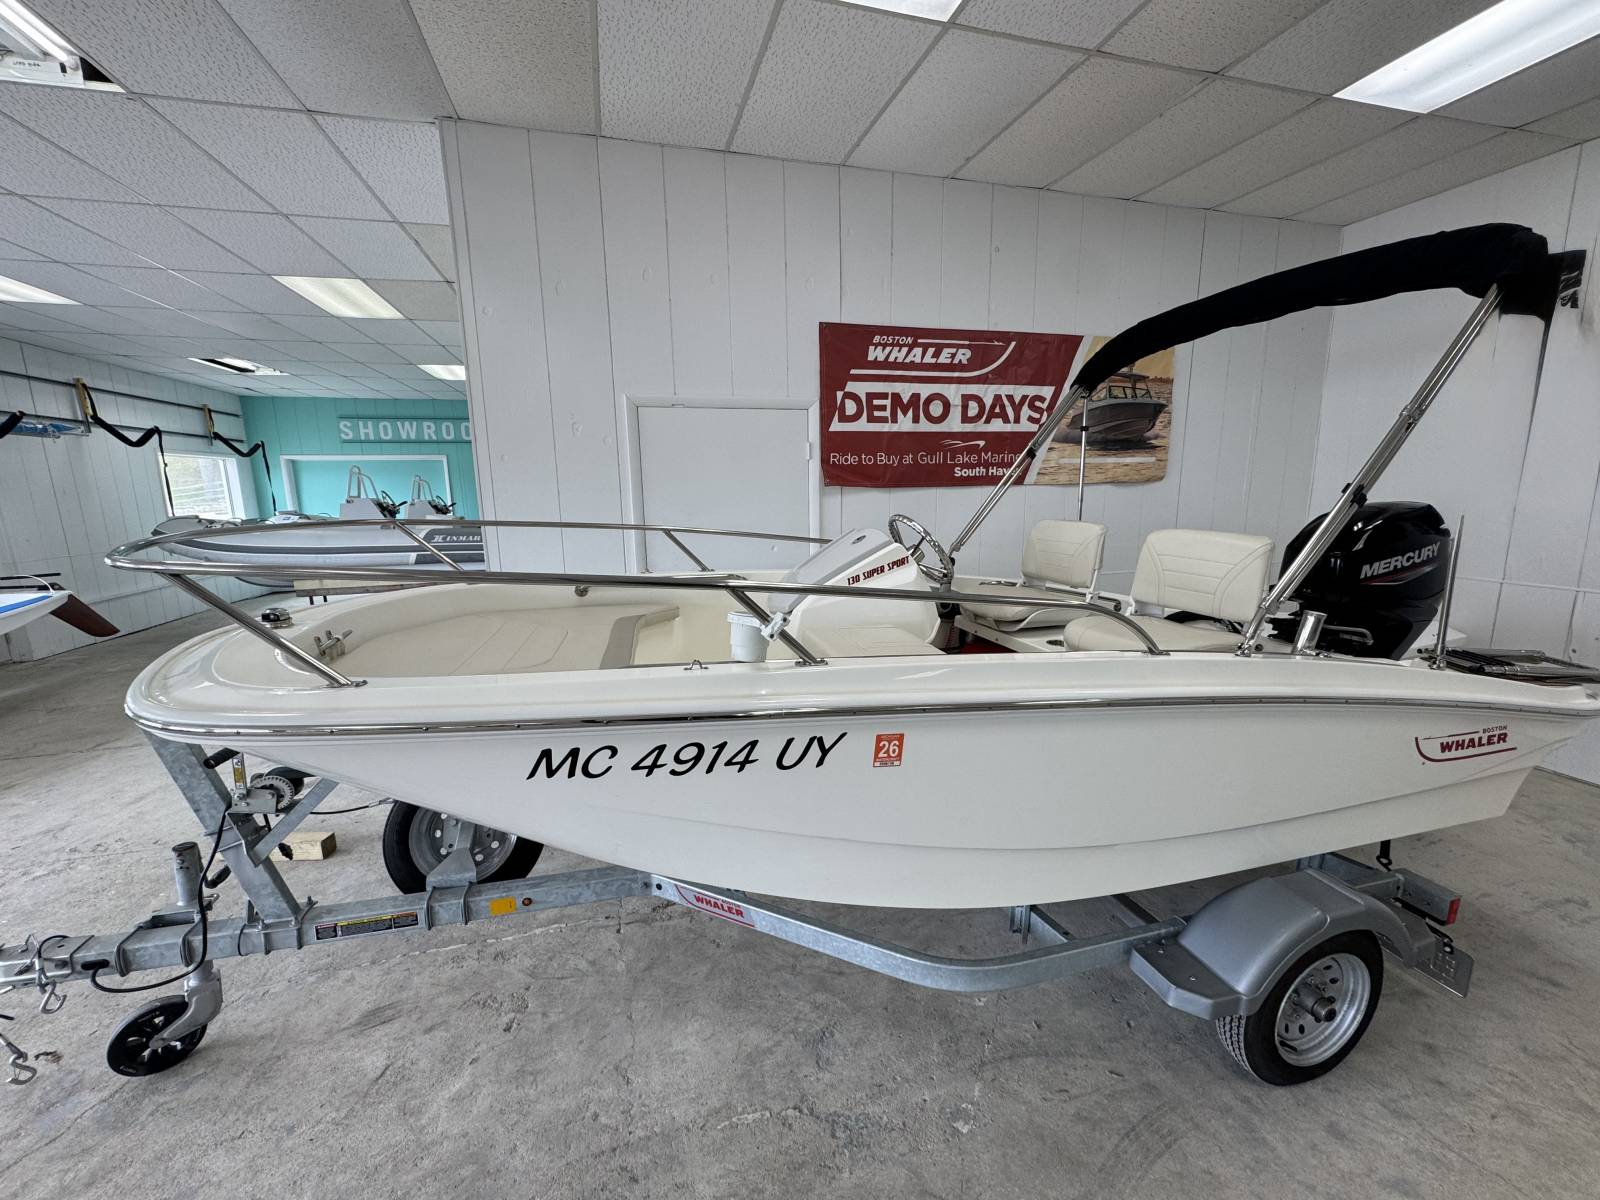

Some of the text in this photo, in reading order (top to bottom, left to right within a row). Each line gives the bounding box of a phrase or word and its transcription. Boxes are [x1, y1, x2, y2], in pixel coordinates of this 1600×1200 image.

[872, 335, 914, 345] BOSTON
[867, 345, 972, 365] WHALER
[837, 391, 1052, 426] DEMO DAYS
[340, 420, 472, 441] SHOWROO
[830, 452, 859, 465] Ride
[861, 453, 874, 465] to
[877, 452, 900, 467] Buy
[902, 454, 914, 465] at
[918, 452, 943, 465] Gull
[947, 451, 978, 464] Lake
[954, 465, 1020, 477] South Hav
[847, 555, 910, 586] 130 SUPER SPORT
[1360, 541, 1440, 579] MERCURY
[1482, 725, 1508, 734] BOSTON
[878, 740, 899, 757] 26
[1440, 732, 1508, 753] WHALER
[526, 732, 848, 780] MC 4914 UY
[694, 894, 744, 919] WHALER
